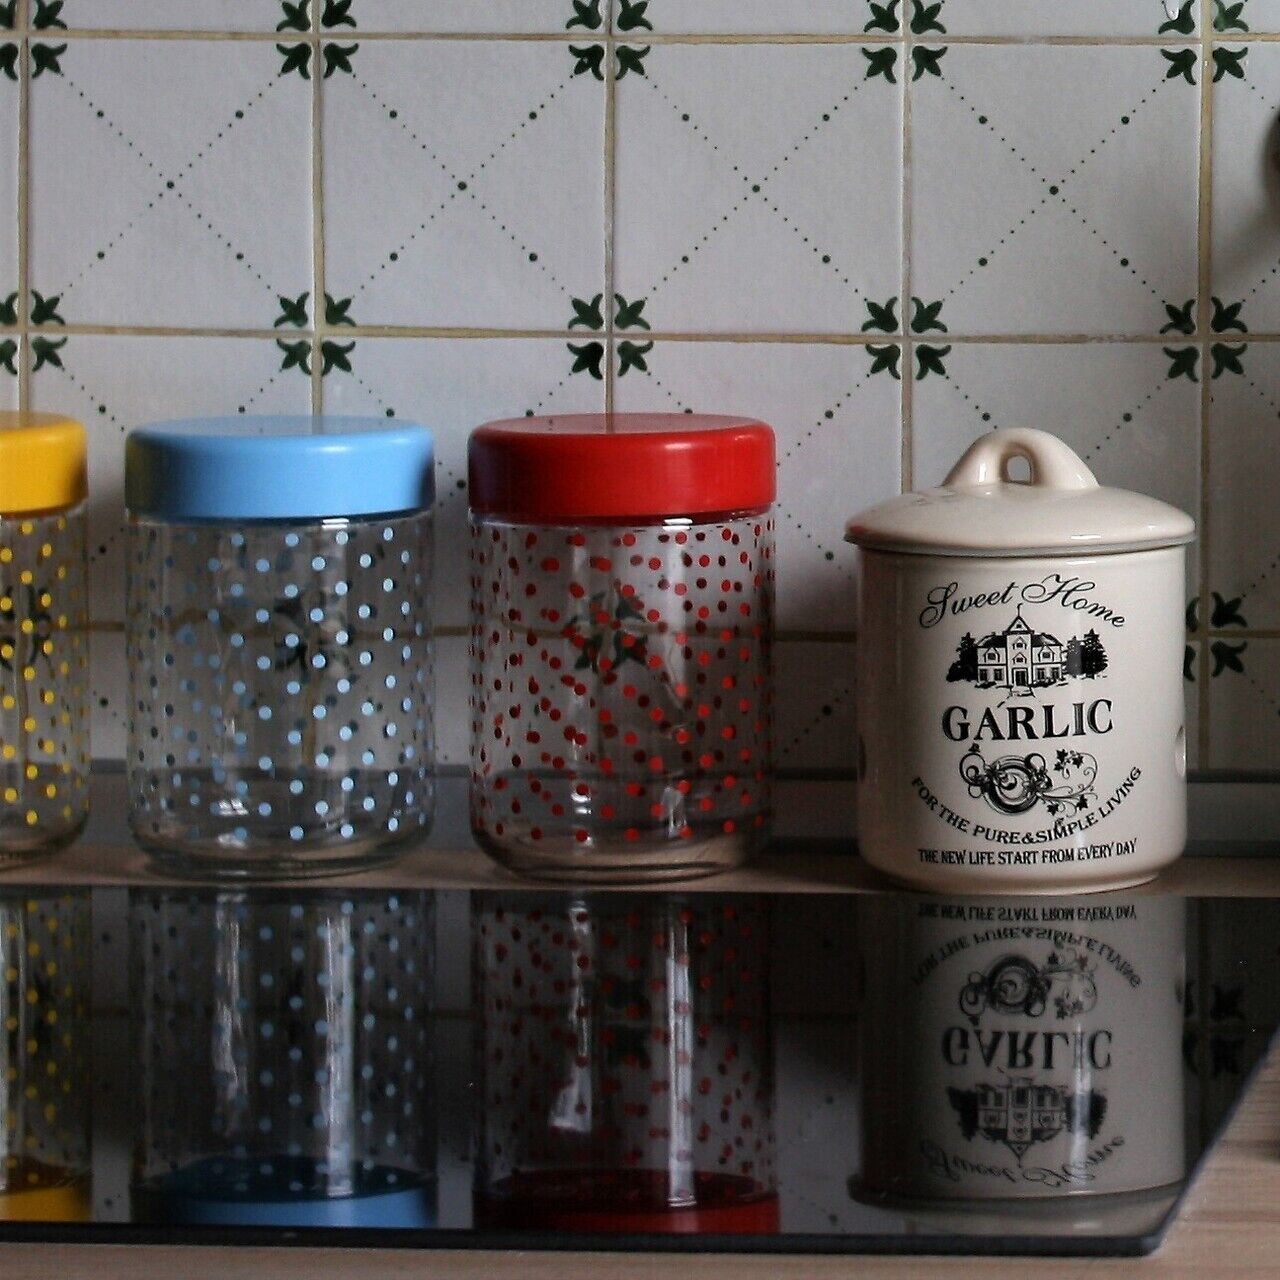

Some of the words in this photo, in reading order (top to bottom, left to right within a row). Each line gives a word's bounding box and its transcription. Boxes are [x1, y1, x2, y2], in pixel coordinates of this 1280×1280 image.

[919, 581, 1018, 628] Sweet
[1021, 573, 1126, 628] Home
[941, 699, 1113, 741] GARLIC
[912, 776, 938, 811] FOR
[937, 804, 969, 833] THE
[1101, 766, 1142, 819] LIVING
[918, 848, 938, 864] THE
[941, 848, 967, 864] NEW
[969, 850, 996, 865] LIFE
[998, 848, 1039, 865] START
[1041, 847, 1074, 864] FROM
[1077, 842, 1115, 861] EVERY
[1116, 838, 1138, 855] DAY
